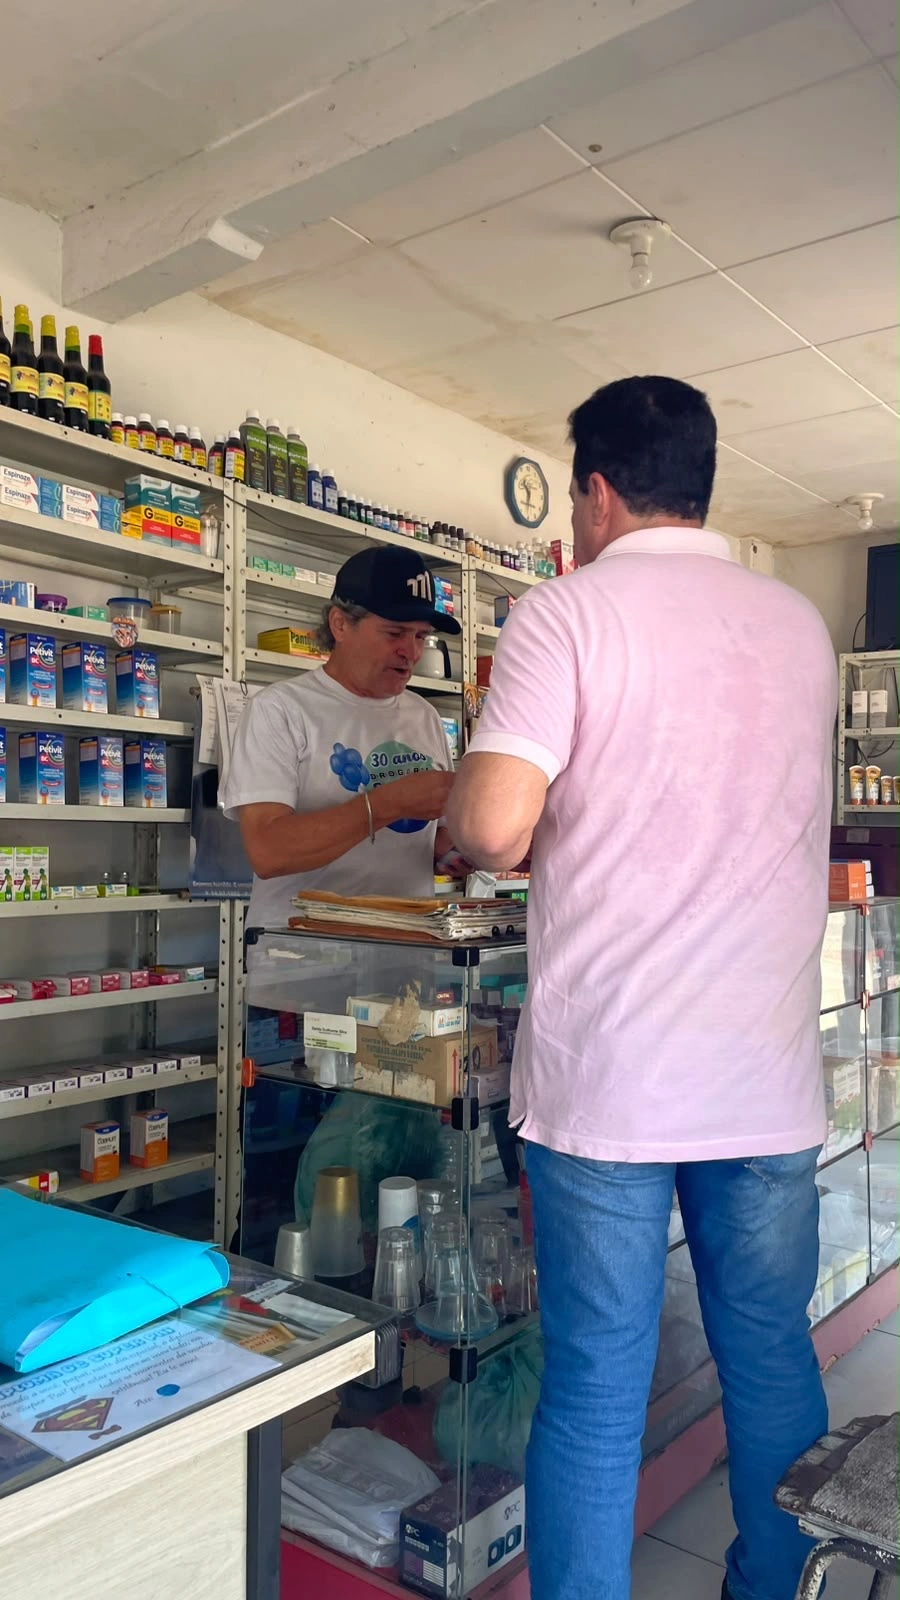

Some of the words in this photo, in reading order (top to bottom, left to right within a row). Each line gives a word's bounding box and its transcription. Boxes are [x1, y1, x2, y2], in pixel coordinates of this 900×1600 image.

[144, 508, 154, 519] G
[174, 515, 184, 527] G
[371, 752, 388, 768] 30
[392, 752, 427, 765] anos
